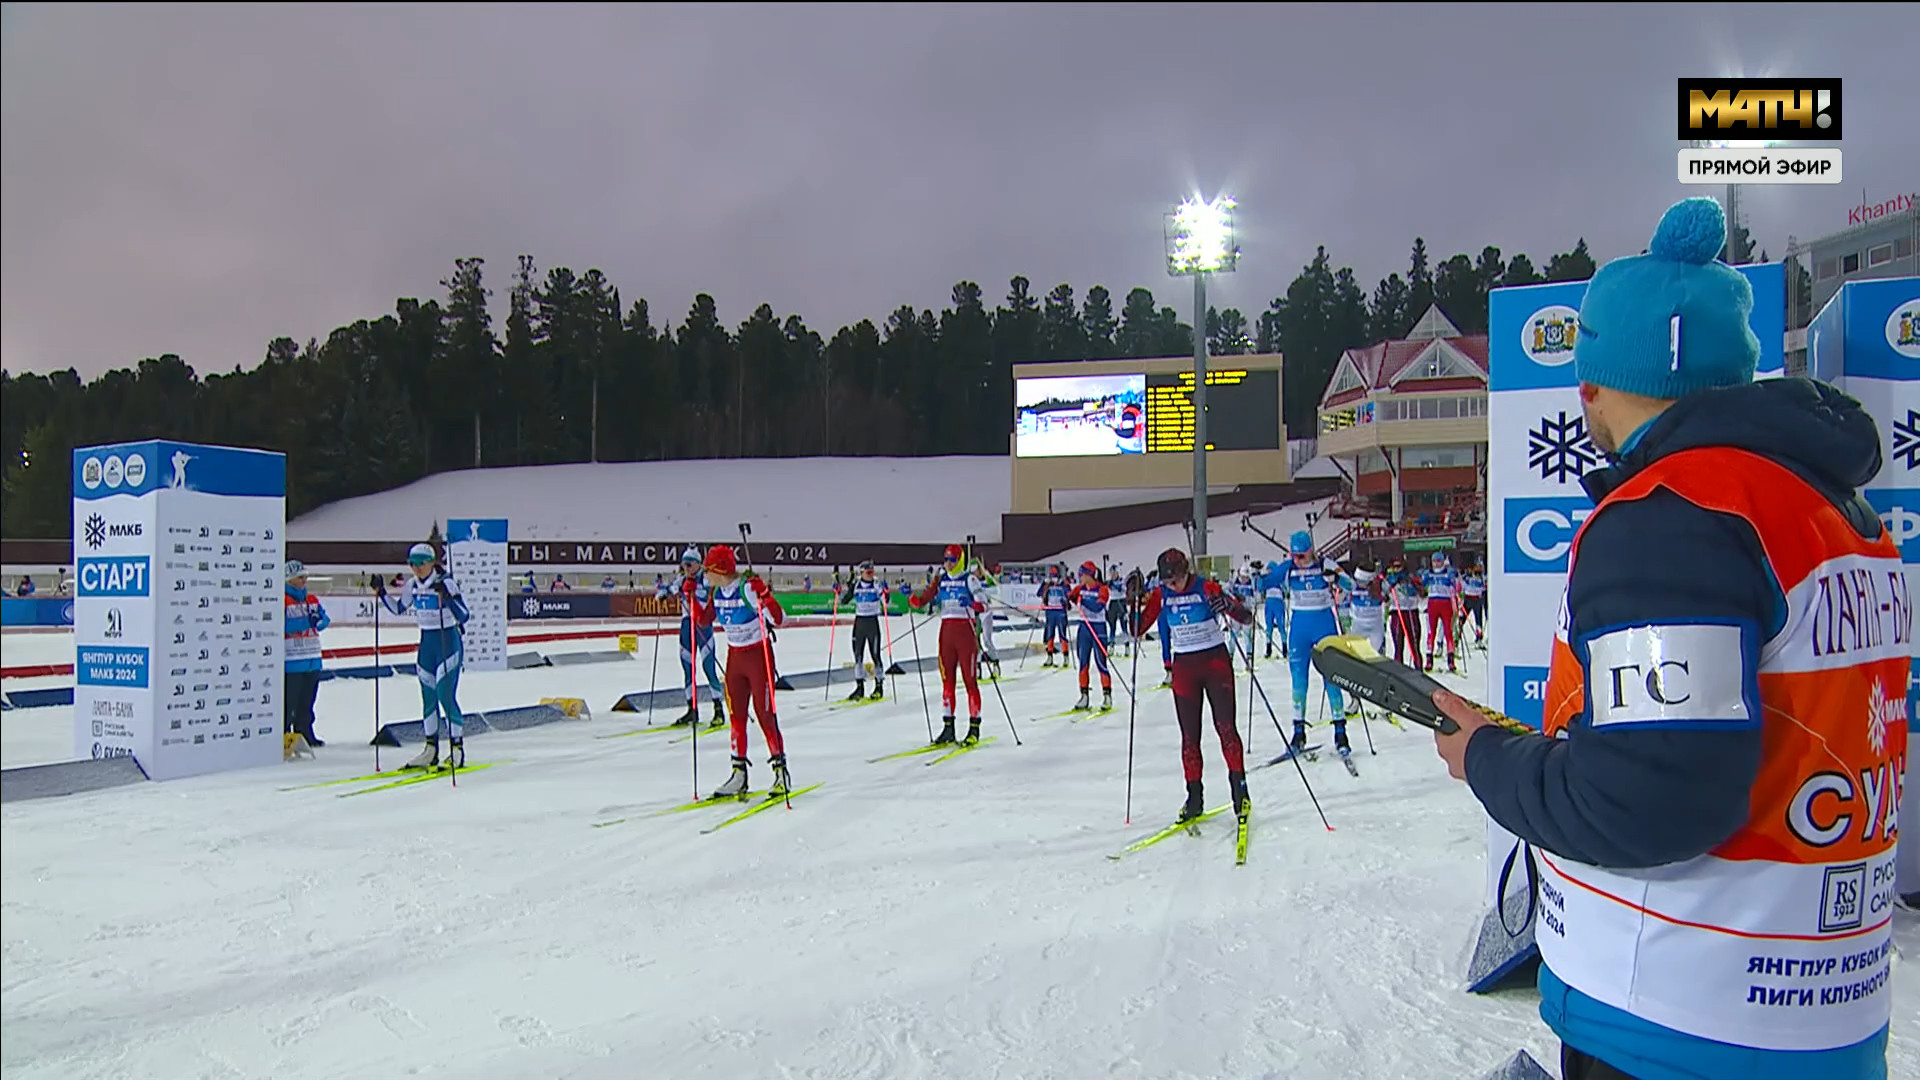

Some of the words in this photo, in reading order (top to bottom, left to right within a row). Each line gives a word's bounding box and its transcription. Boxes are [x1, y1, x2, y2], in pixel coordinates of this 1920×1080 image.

[109, 524, 142, 537] МЛКБ
[775, 546, 828, 561] 2024
[81, 562, 146, 591] СТАРТ
[724, 615, 731, 624] 2
[1180, 613, 1189, 624] 3
[115, 668, 136, 681] 2024
[1609, 660, 1690, 710] ГС
[1833, 878, 1857, 905] RS
[1833, 903, 1856, 921] 1912
[1746, 956, 1837, 977] ЯНГПУР
[1841, 946, 1880, 973] КУБОК
[1746, 985, 1814, 1006] ЛИГИ
